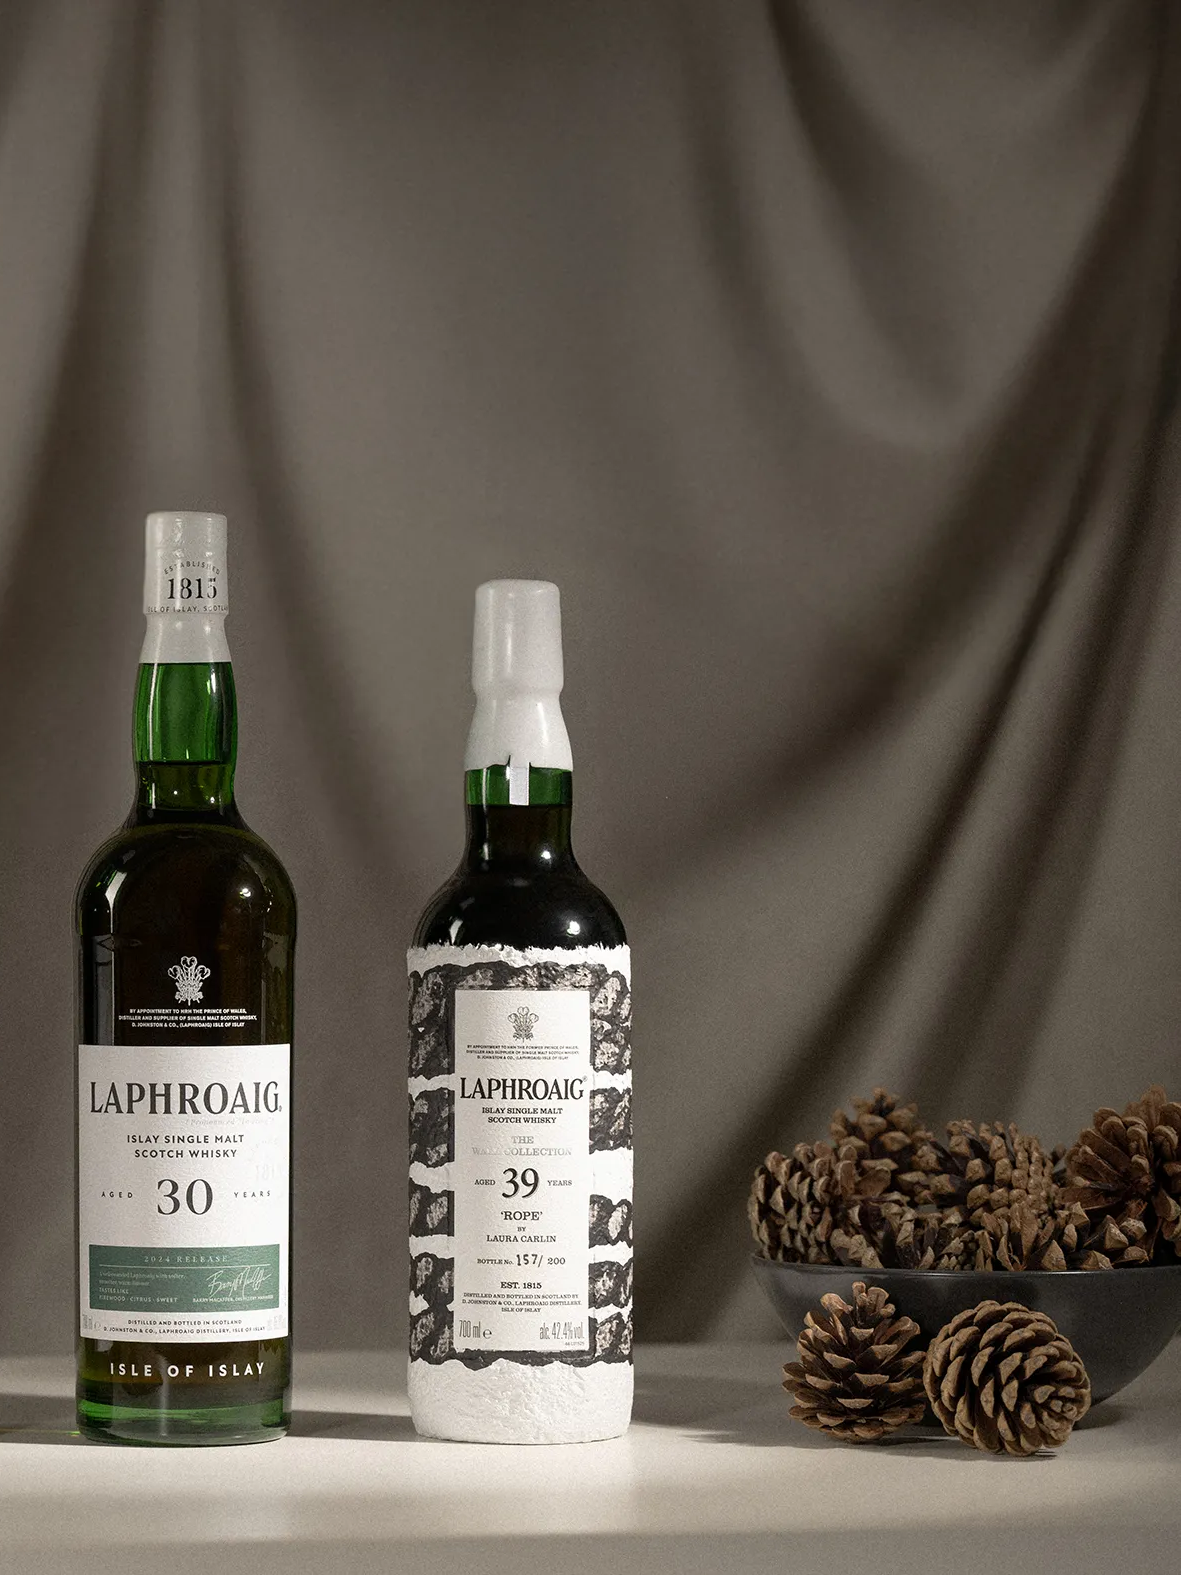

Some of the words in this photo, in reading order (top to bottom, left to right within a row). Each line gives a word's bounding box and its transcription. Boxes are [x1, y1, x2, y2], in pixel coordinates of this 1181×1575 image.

[168, 577, 217, 600] 1815
[482, 1107, 507, 1115] ISLAY
[507, 1107, 539, 1115] SINGLE
[540, 1107, 563, 1115] MALT
[127, 1135, 160, 1144] ISLAY
[164, 1135, 209, 1144] SINGLE
[214, 1134, 245, 1143] MALT
[511, 1136, 534, 1144] THE
[134, 1149, 184, 1158] SCOTCH
[189, 1149, 237, 1158] WHISKY
[504, 1147, 572, 1156] COLLECTION
[501, 1167, 540, 1199] 39
[101, 1191, 134, 1199] AGED
[157, 1178, 213, 1216] 30
[234, 1190, 271, 1198] YEARS
[486, 1235, 520, 1243] LAURA
[521, 1235, 557, 1243] CARLIN
[144, 1255, 172, 1263] 2024
[176, 1255, 229, 1263] RELEASE
[547, 1257, 566, 1265] 200
[459, 1320, 472, 1338] 700
[473, 1321, 481, 1338] ml
[110, 1362, 152, 1377] ISLE
[167, 1365, 194, 1378] OF
[209, 1362, 265, 1377] ISLAY
